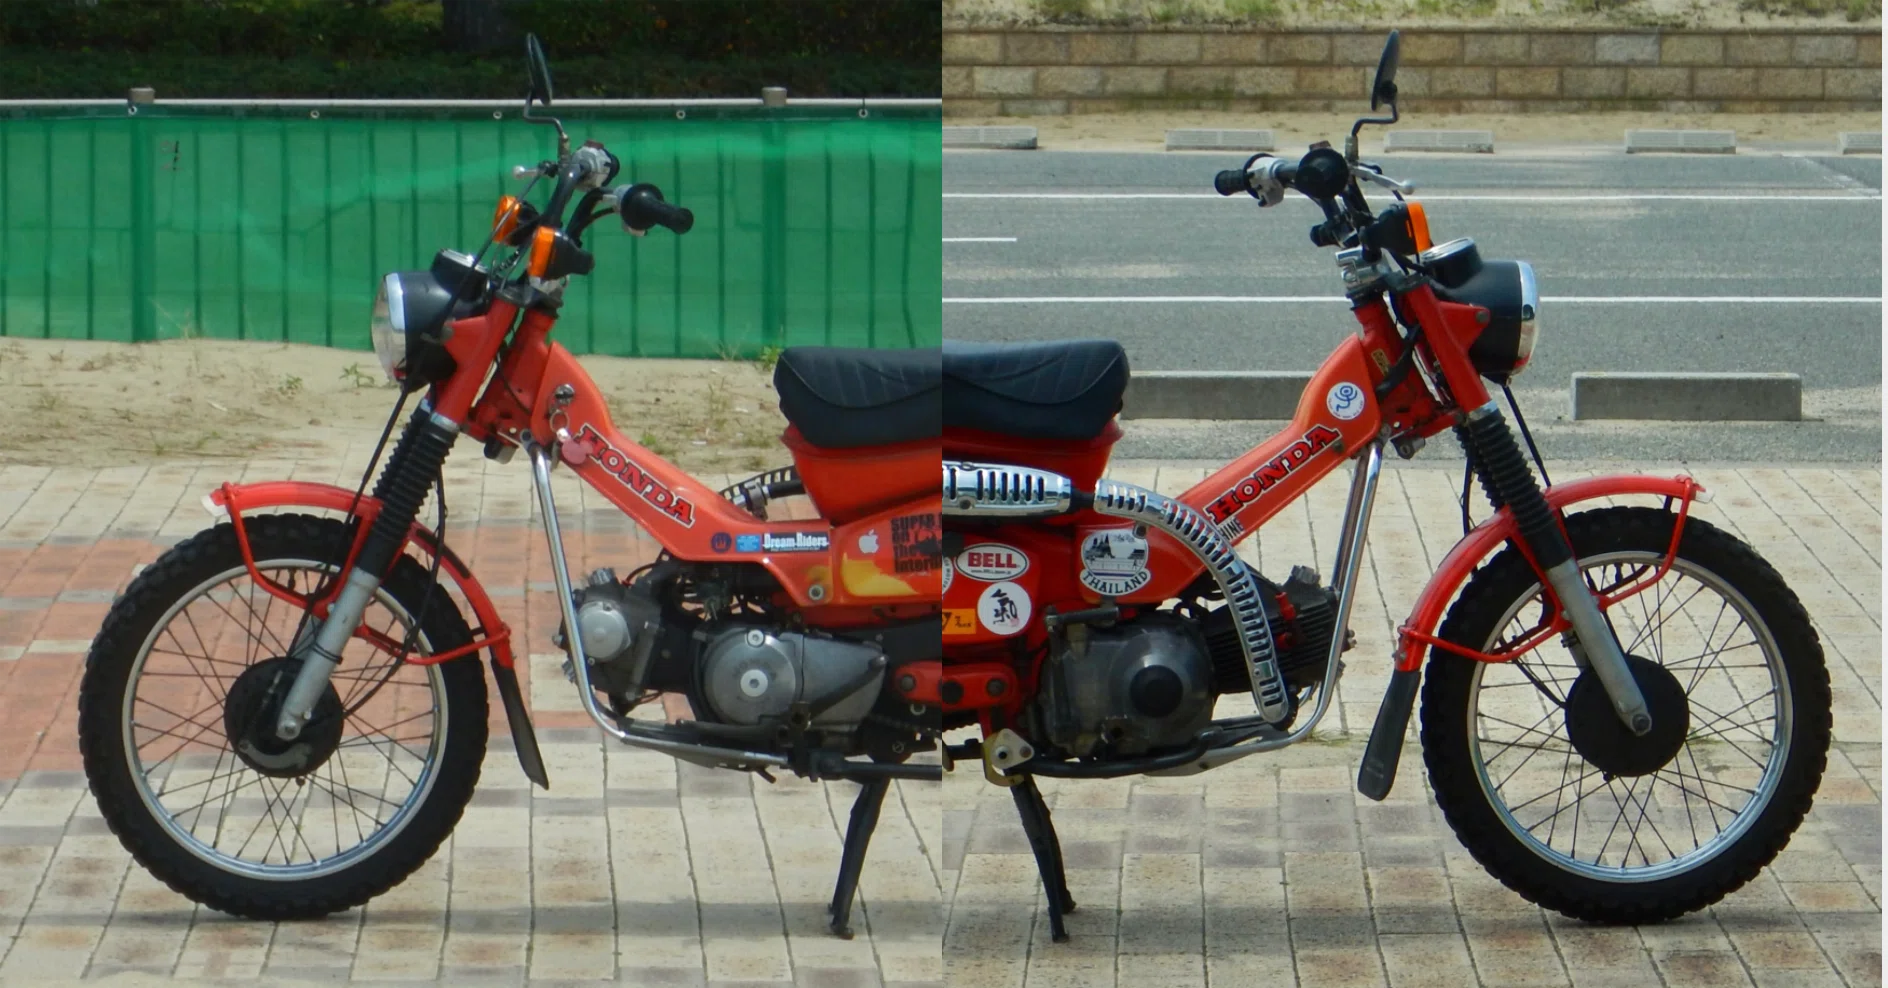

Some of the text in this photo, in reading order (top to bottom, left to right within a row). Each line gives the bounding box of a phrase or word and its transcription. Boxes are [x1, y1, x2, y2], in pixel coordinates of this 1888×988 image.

[572, 423, 696, 529] HONDA
[1203, 424, 1342, 527] HONDA
[763, 533, 795, 549] Dream
[796, 531, 828, 547] Riders
[968, 552, 1017, 568] BELL
[1083, 571, 1148, 594] THAILAND
